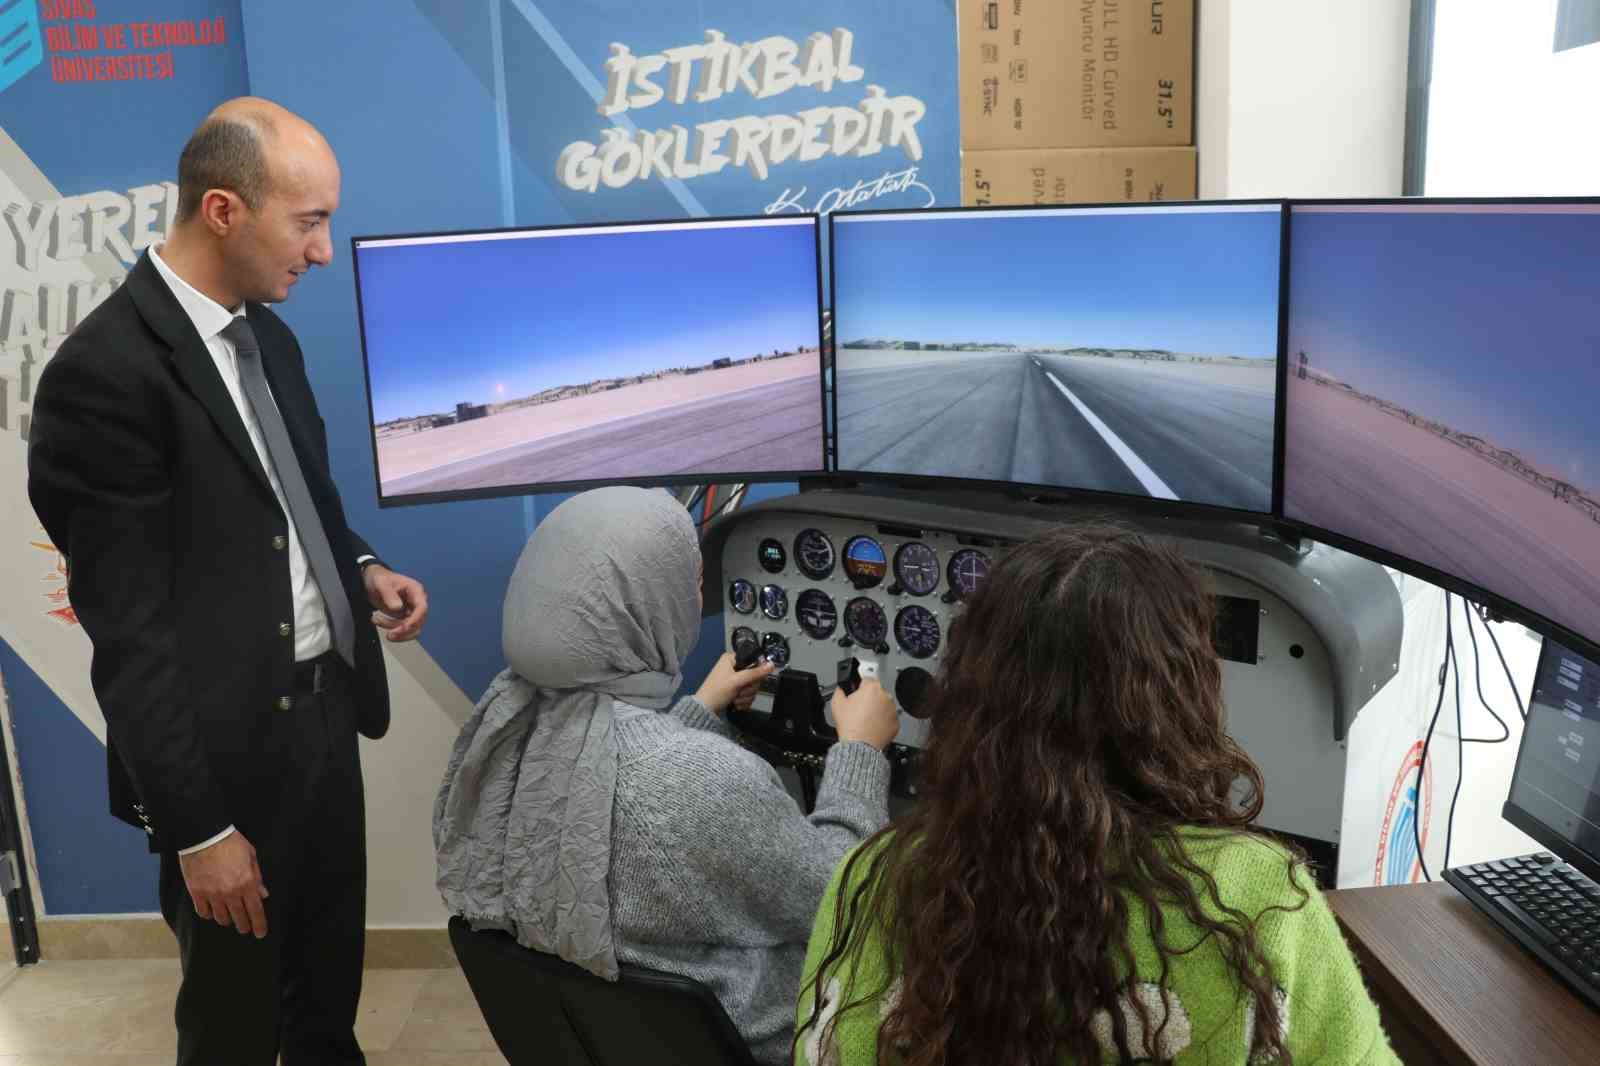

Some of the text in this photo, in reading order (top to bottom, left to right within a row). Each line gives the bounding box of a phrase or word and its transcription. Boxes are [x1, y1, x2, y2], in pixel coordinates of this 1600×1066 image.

[100, 24, 127, 49] VE
[1103, 37, 1119, 62] HD
[598, 27, 864, 116] İSTİKBAL
[1103, 69, 1119, 130] Curved
[1157, 79, 1173, 129] 31.5"
[556, 84, 926, 193] GÖKLERDEDİR
